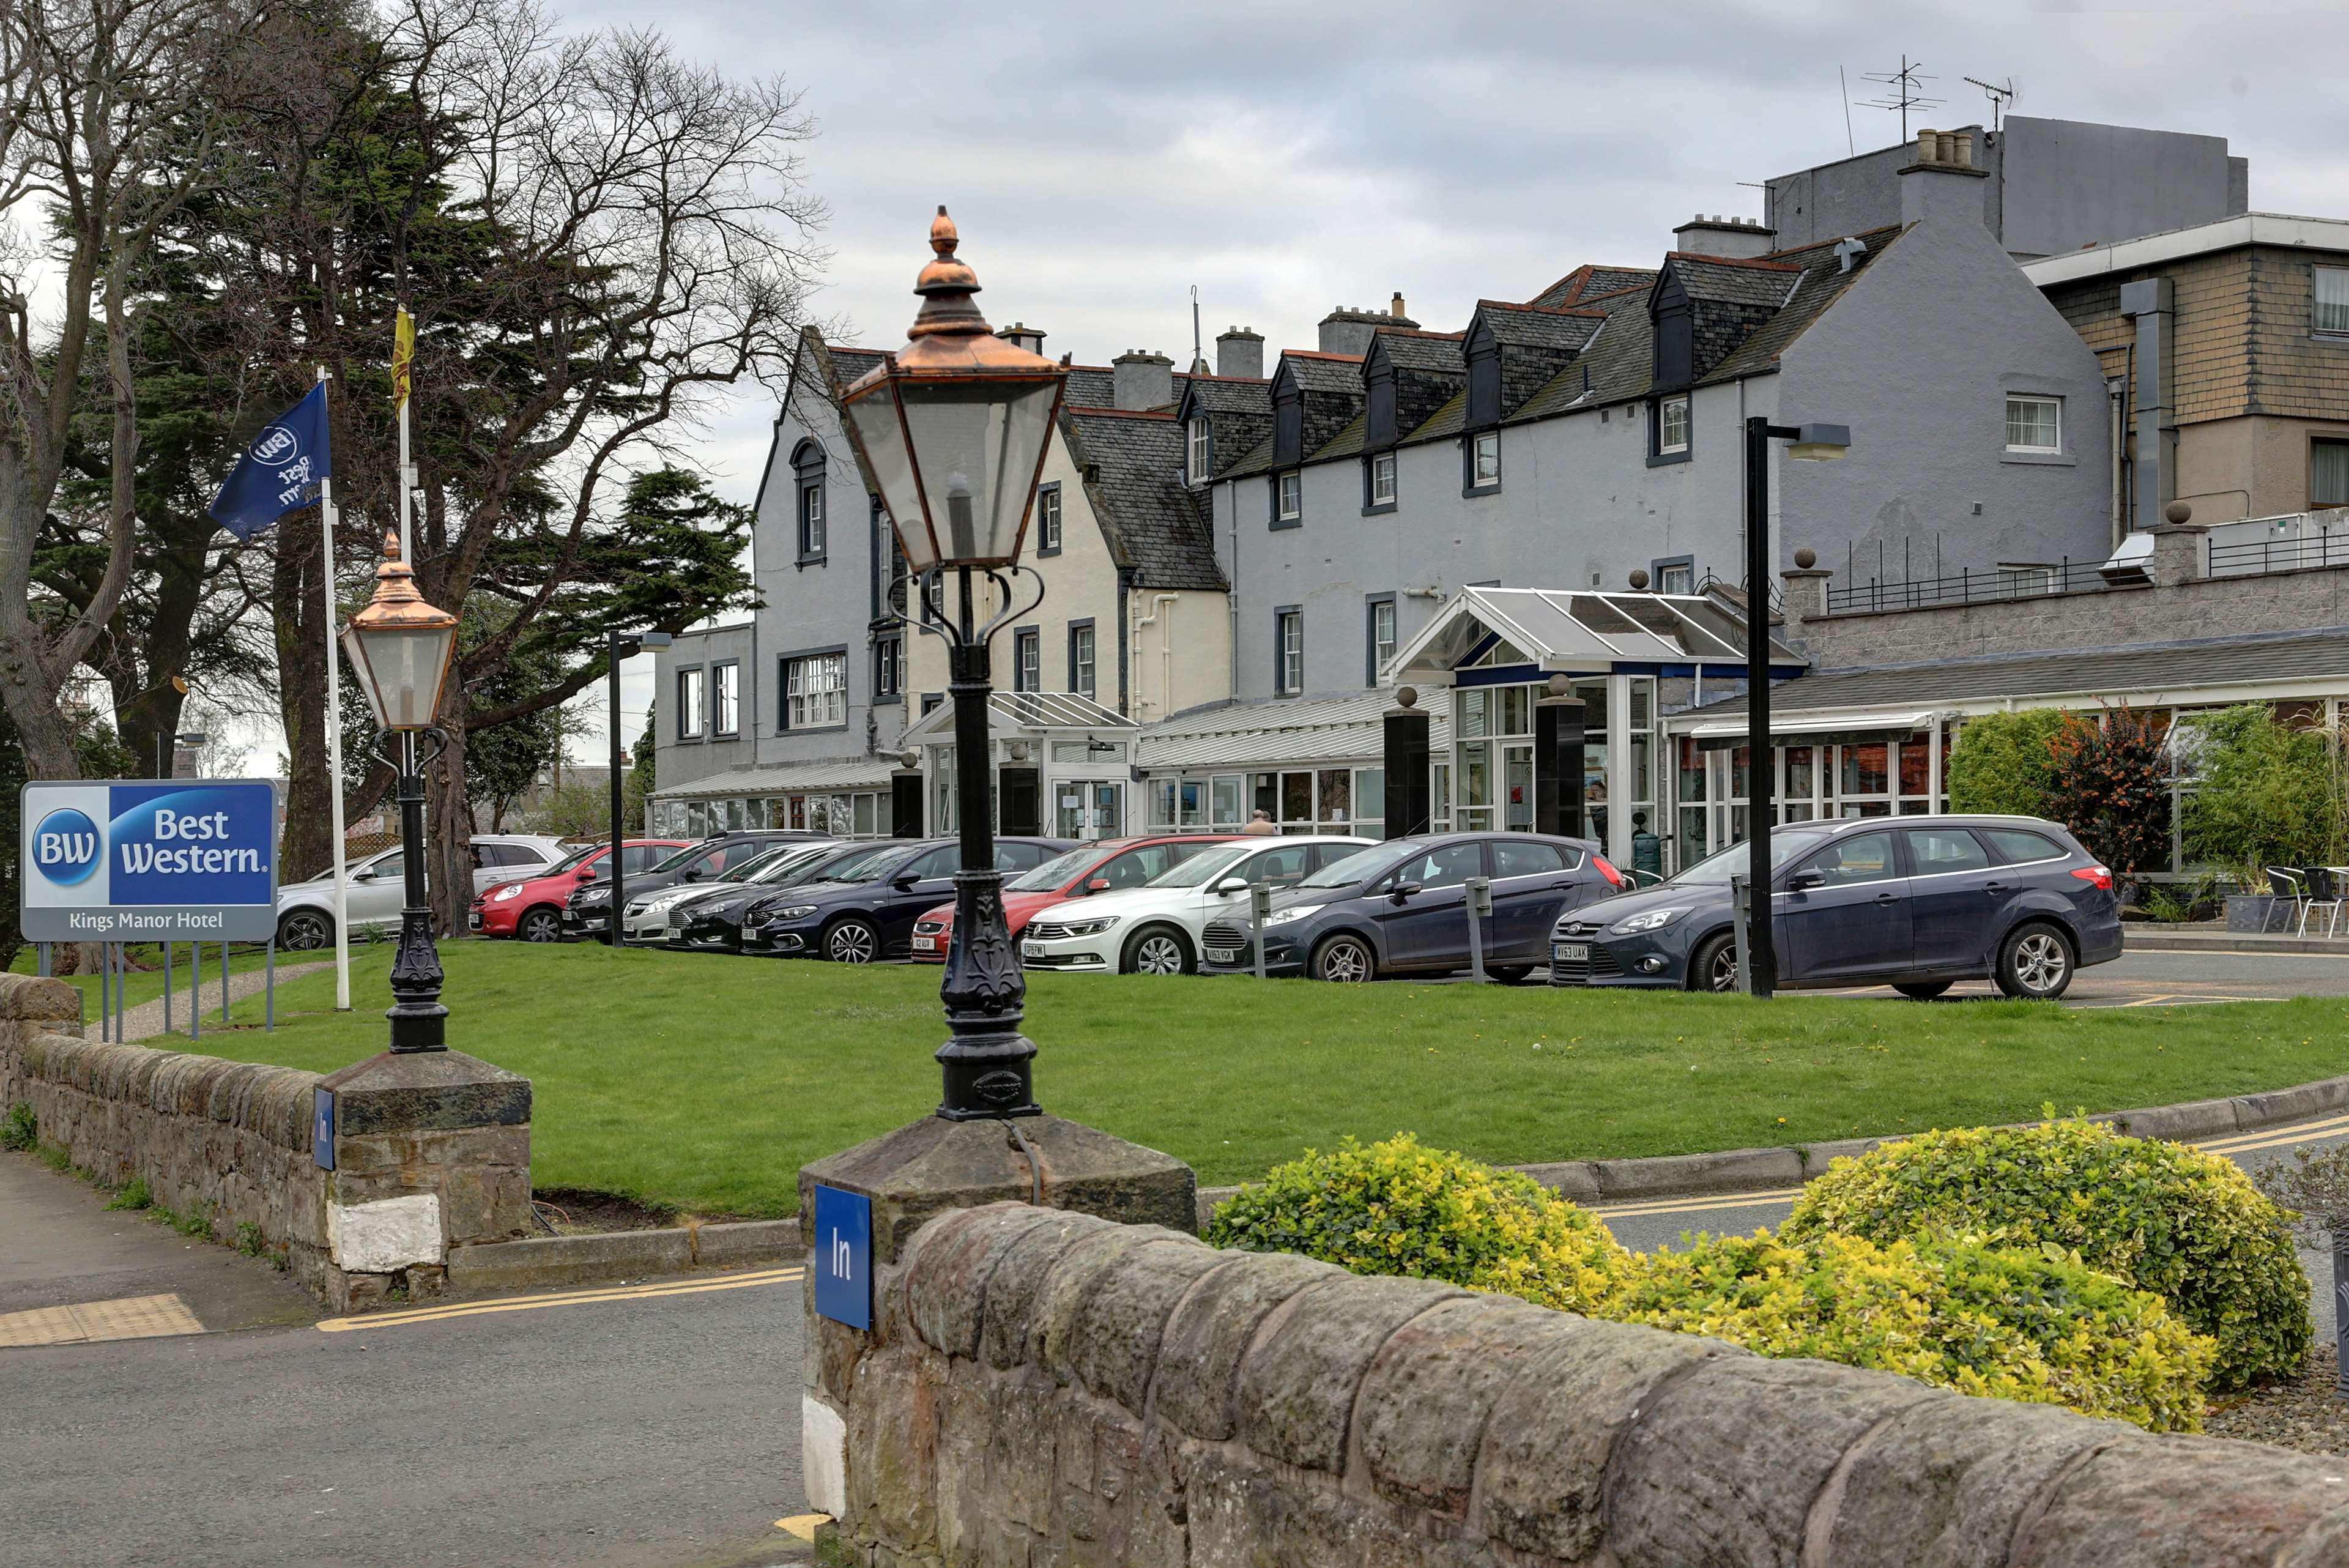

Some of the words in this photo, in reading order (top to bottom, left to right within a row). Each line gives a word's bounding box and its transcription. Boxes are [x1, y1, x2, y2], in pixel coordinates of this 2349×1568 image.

[155, 809, 229, 841] Best
[40, 833, 95, 864] BW
[70, 912, 114, 932] Kings
[119, 913, 173, 928] Manor
[177, 912, 223, 927] Hotel
[1573, 946, 1586, 958] UAK
[833, 1227, 851, 1280] In
